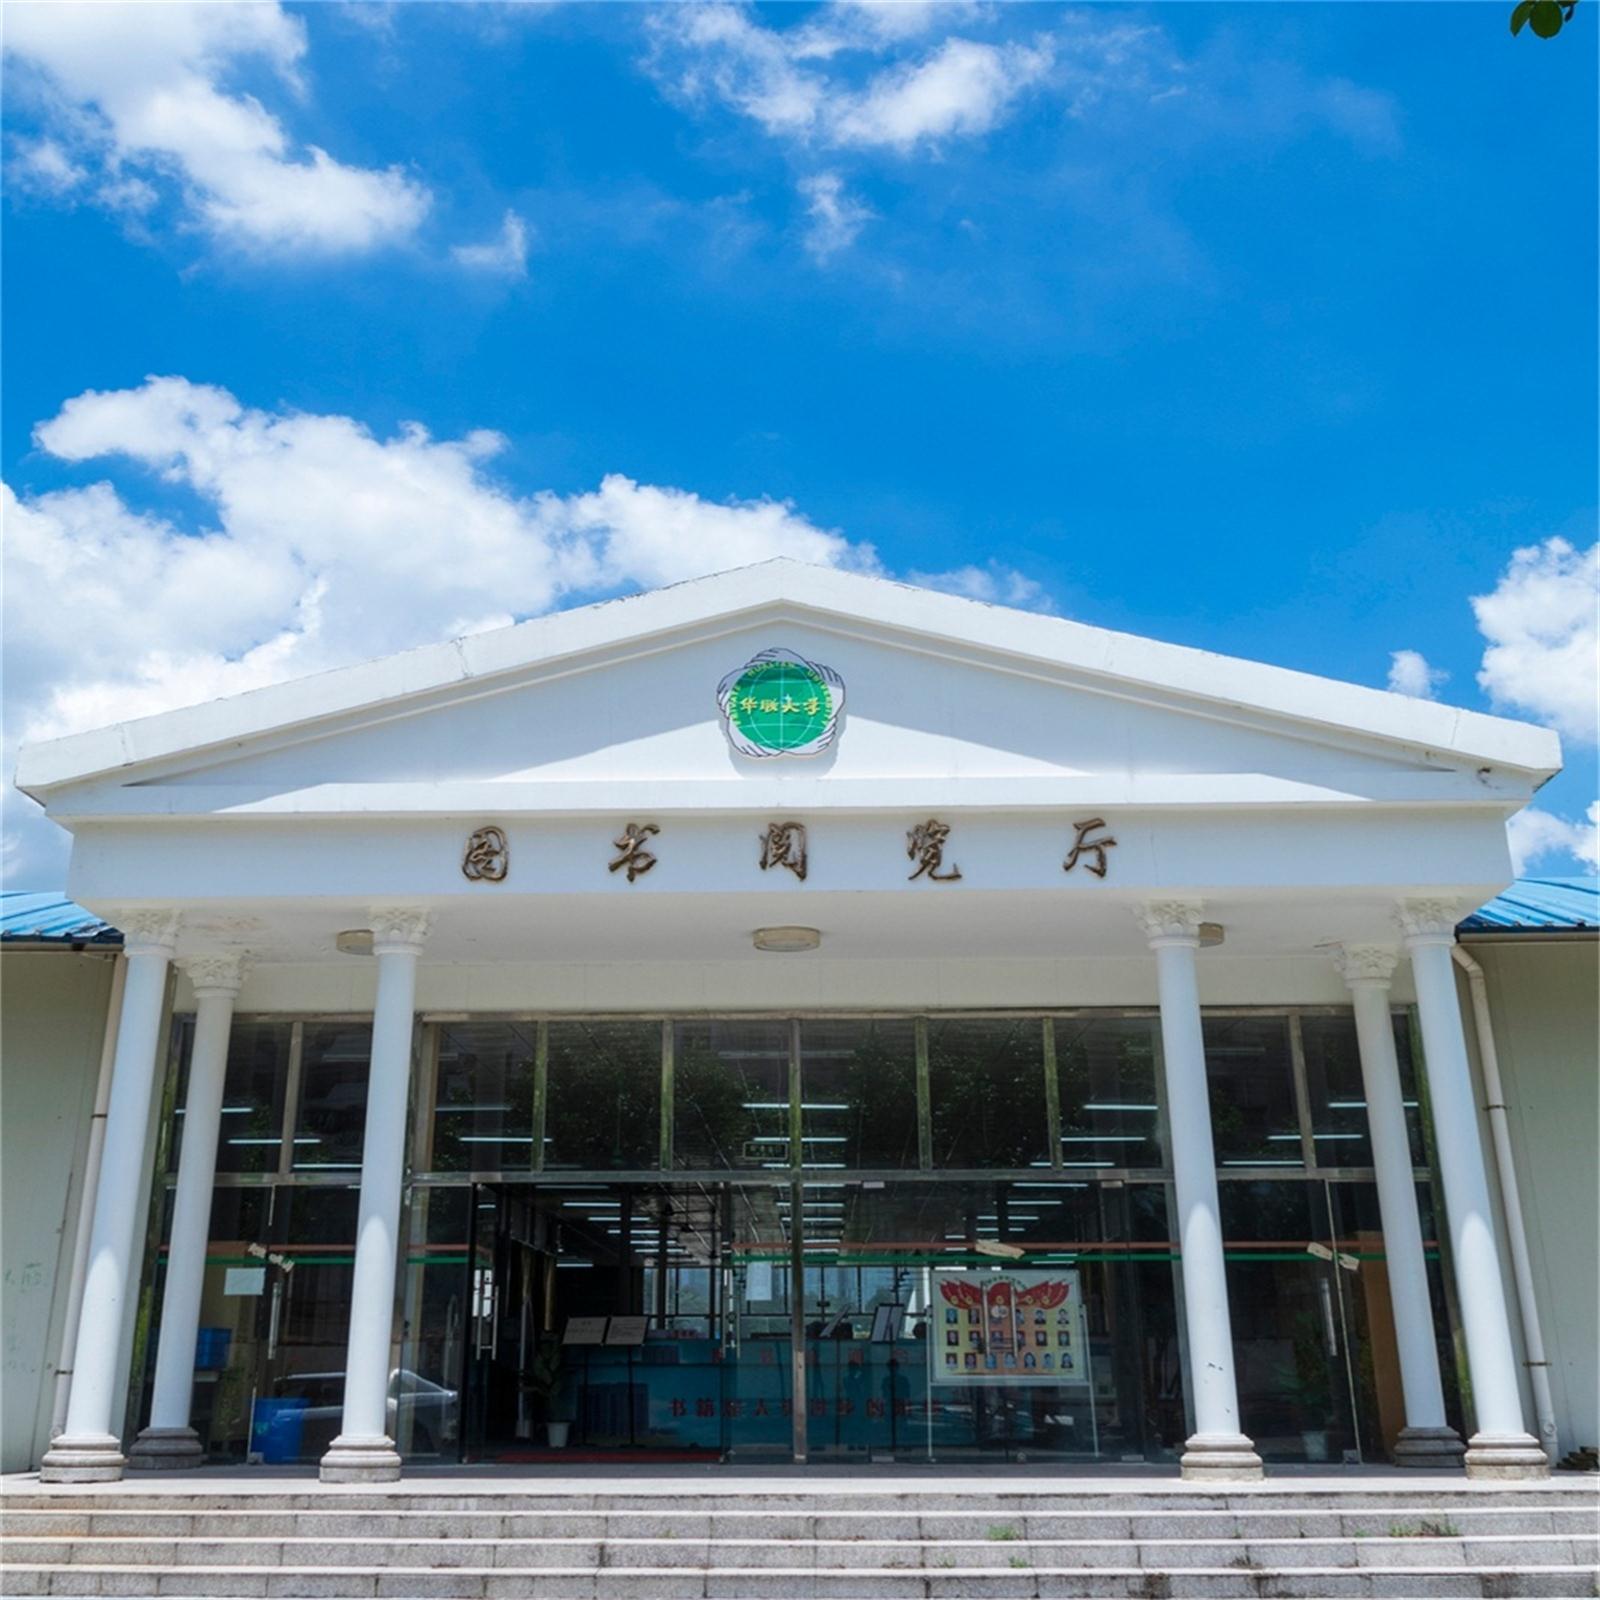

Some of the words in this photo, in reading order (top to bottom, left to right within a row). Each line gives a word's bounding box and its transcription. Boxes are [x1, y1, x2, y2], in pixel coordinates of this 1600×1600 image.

[461, 817, 1118, 883] 图书阅览厅
